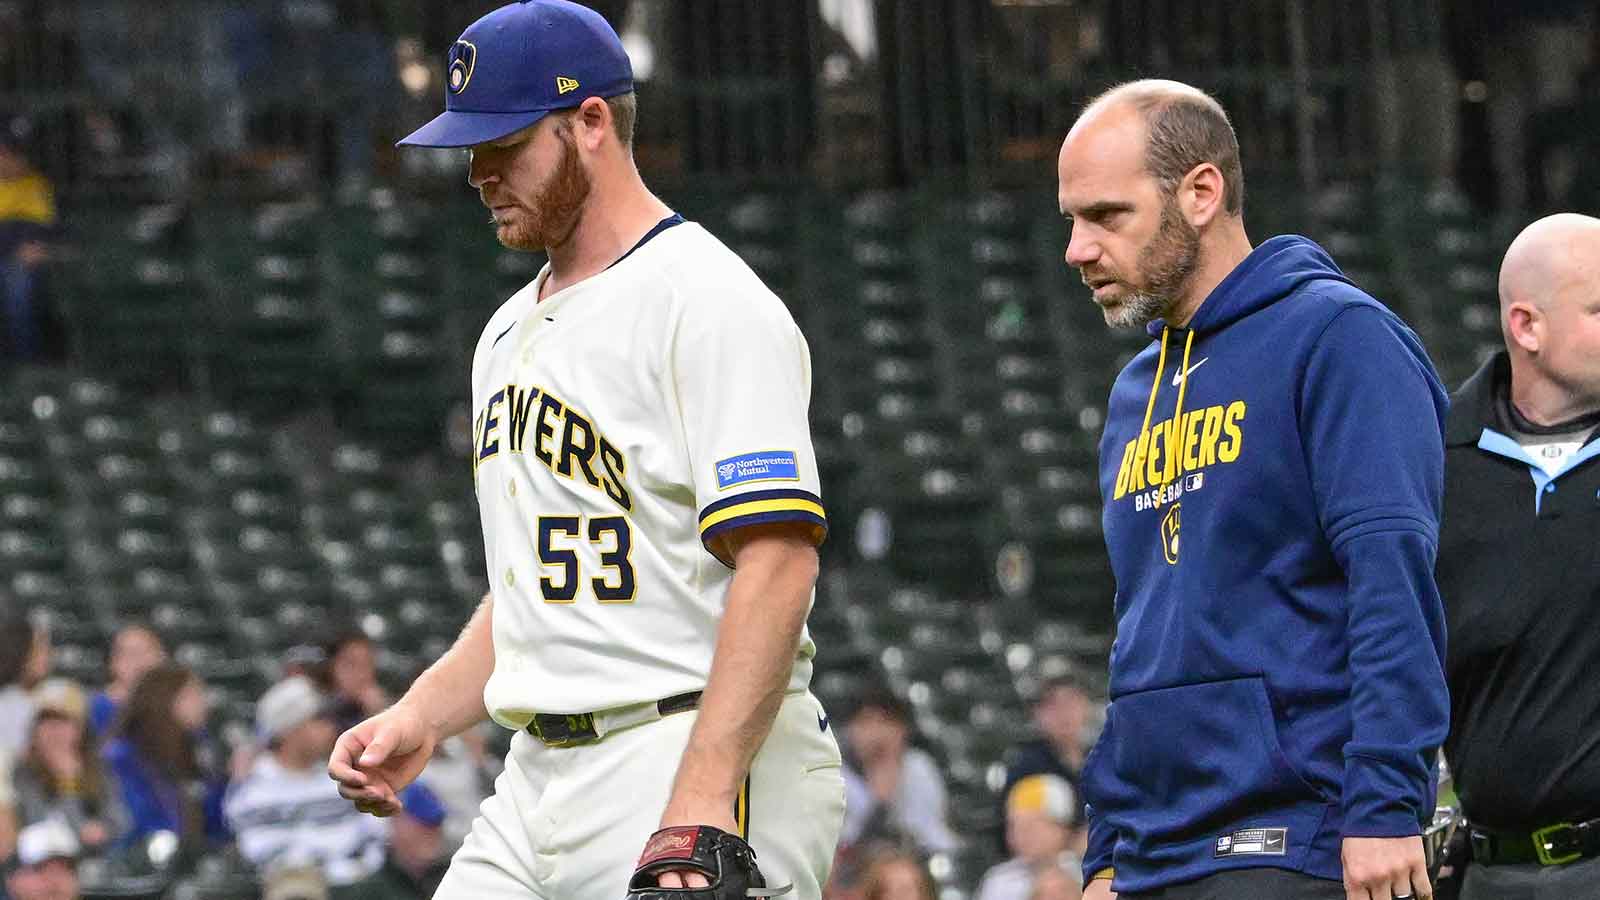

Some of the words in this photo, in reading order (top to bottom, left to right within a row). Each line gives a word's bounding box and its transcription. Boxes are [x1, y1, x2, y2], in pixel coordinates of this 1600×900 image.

[735, 457, 795, 469] Northwestern
[737, 465, 769, 477] Mutual
[1113, 400, 1247, 500] BREWERS
[536, 514, 639, 604] 53
